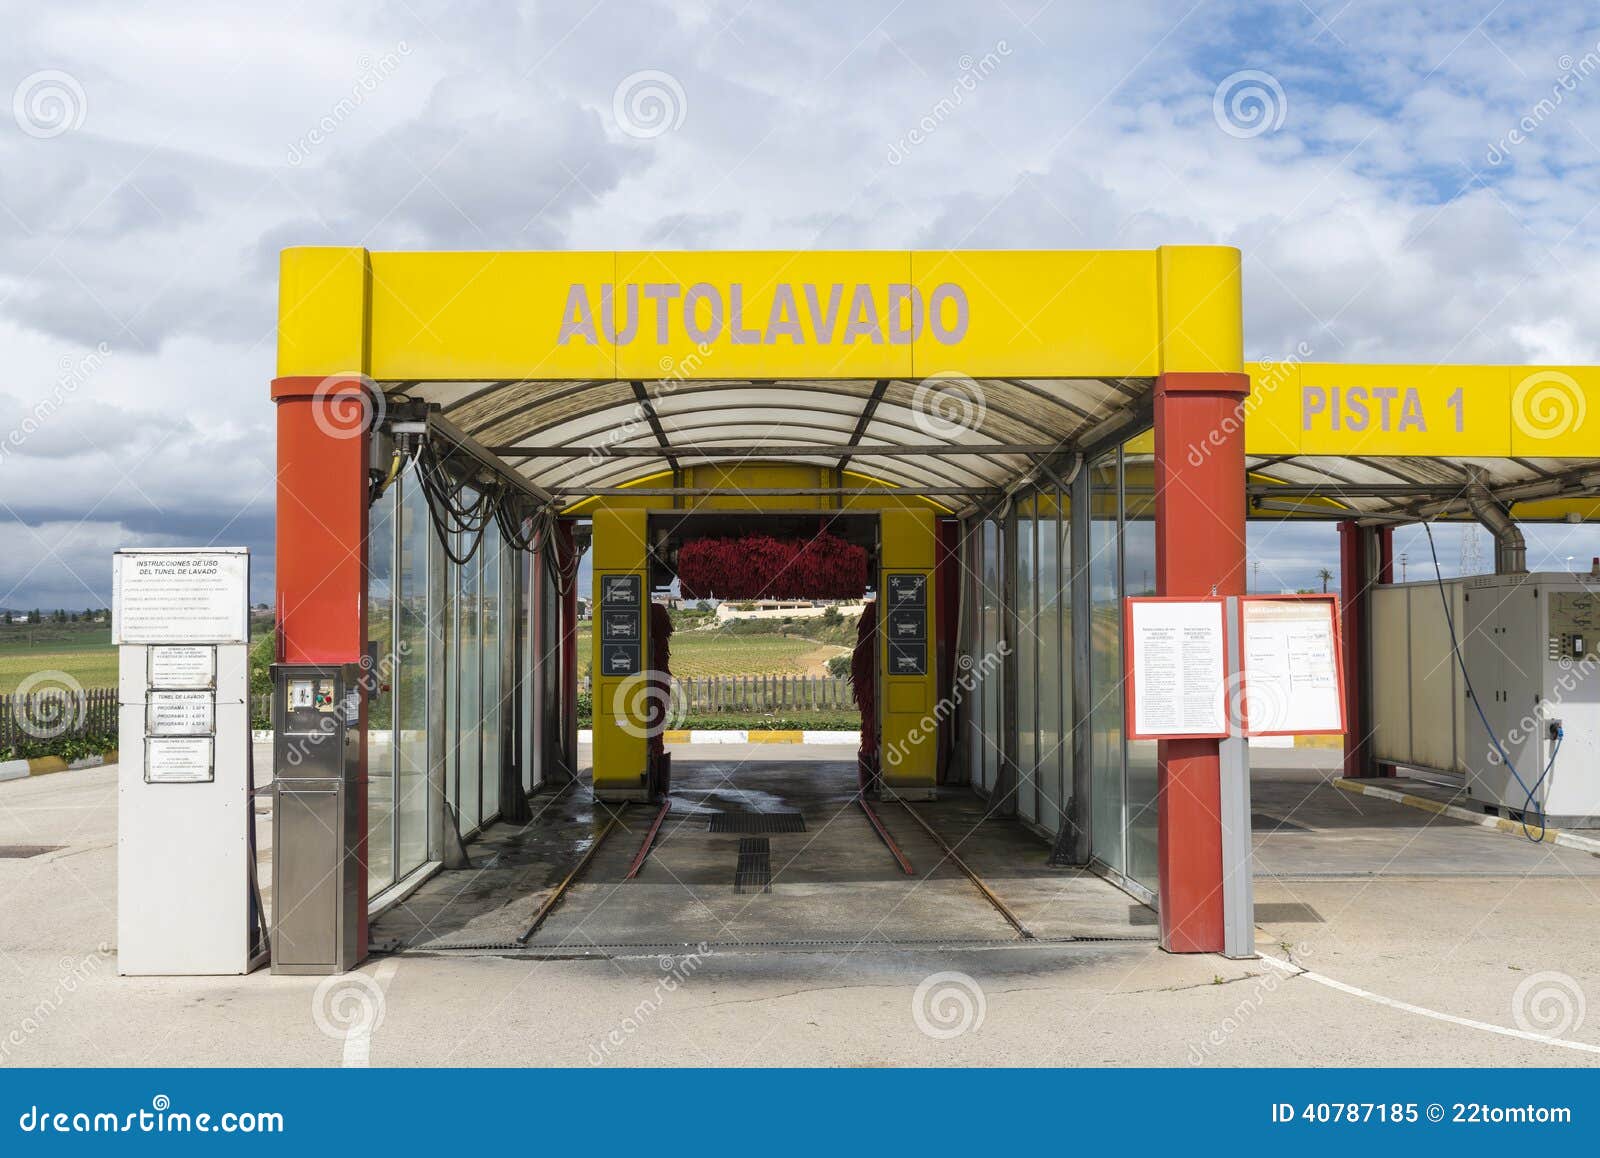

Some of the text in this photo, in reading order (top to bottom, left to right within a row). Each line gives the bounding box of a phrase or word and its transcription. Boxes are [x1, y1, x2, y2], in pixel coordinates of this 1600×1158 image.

[556, 282, 970, 346] AUTOLAVADO
[1302, 386, 1464, 433] PISTA 1
